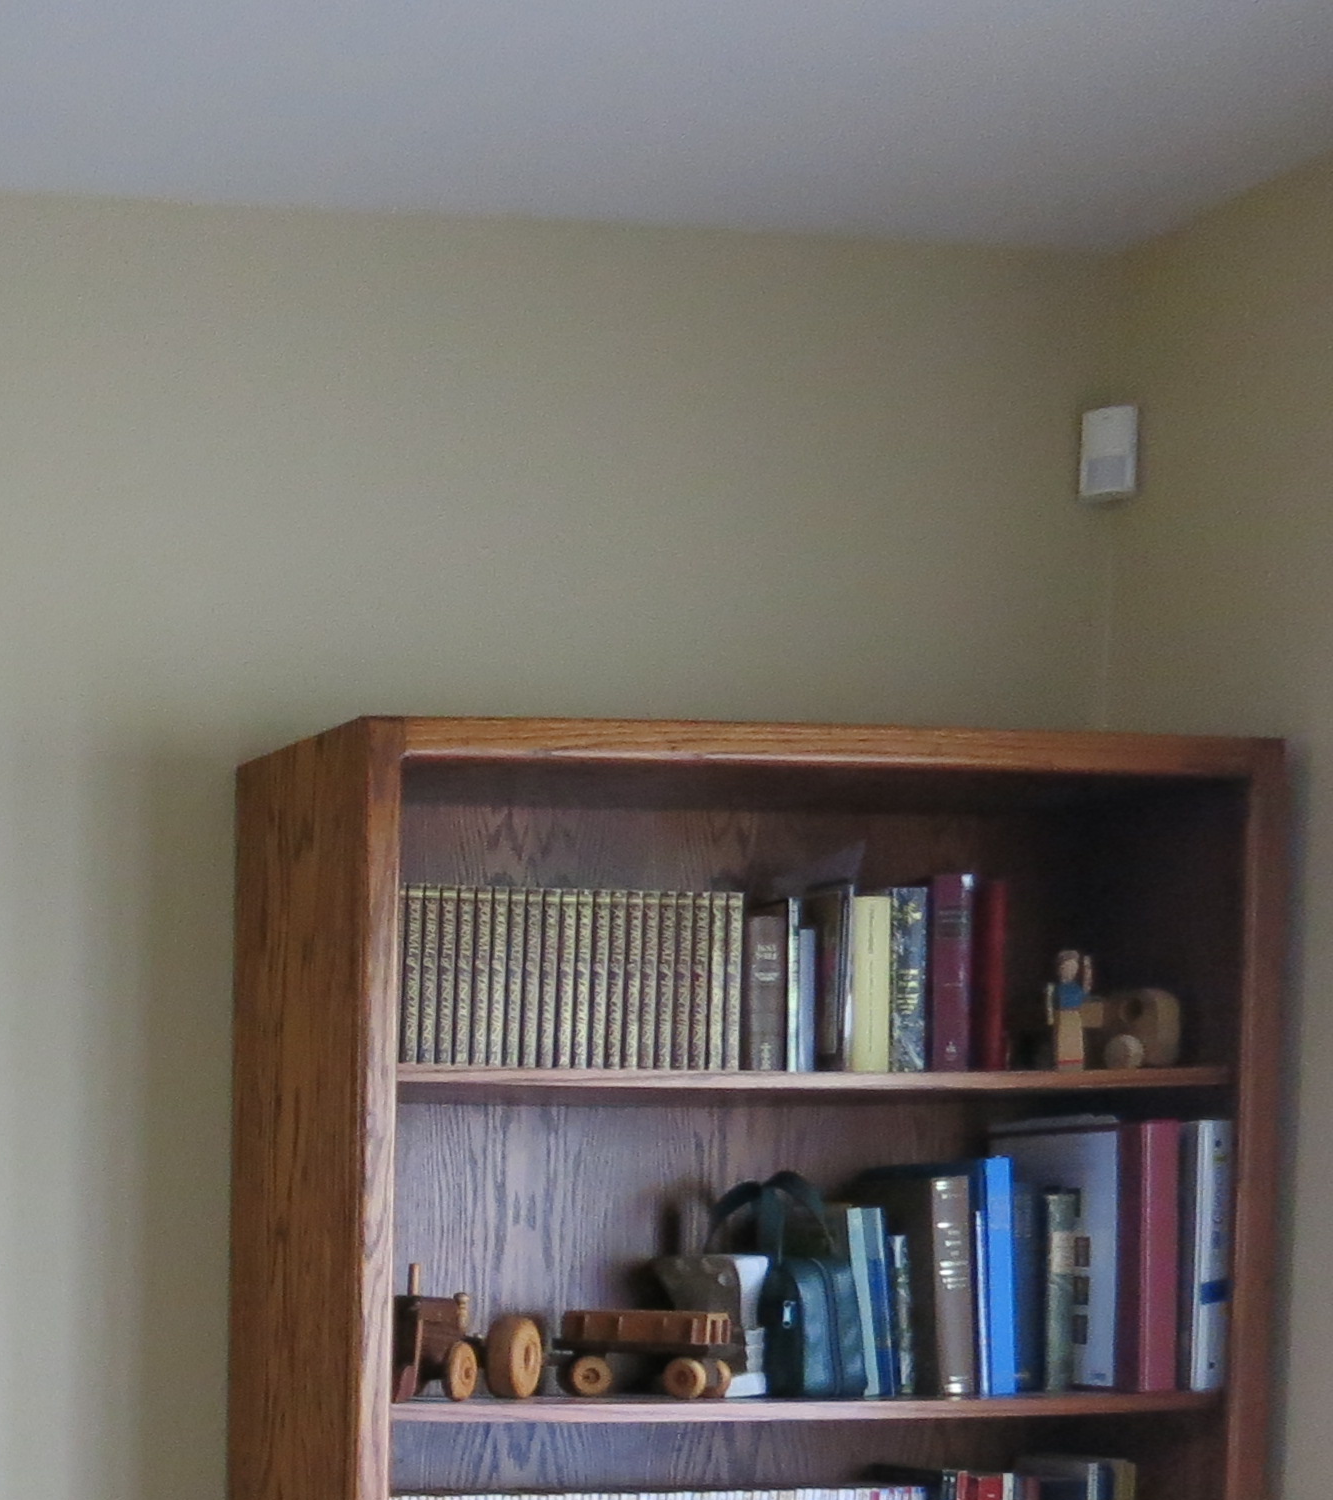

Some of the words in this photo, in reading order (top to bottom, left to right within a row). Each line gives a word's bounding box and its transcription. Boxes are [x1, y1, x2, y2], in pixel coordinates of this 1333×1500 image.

[408, 900, 421, 955] JOURNAL
[424, 900, 437, 956] JOURNAL
[442, 901, 454, 956] JOURNAL
[460, 902, 472, 958] JOURNAL
[478, 902, 491, 958] JOURNAL
[495, 904, 508, 959] JOURNAL
[511, 904, 524, 959] JOURNAL
[527, 905, 540, 960] JOURNAL
[545, 905, 558, 962] JOURNAL
[563, 906, 574, 962] JOURNAL
[578, 905, 591, 962] JOURNAL
[595, 906, 608, 962] JOURNAL
[612, 907, 624, 962] JOURNAL
[629, 907, 642, 963] JOURNAL
[645, 907, 658, 962] JOURNAL
[661, 908, 674, 964] JOURNAL
[679, 909, 691, 963] JOURNAL
[696, 909, 708, 963] JOURNAL
[729, 909, 742, 964] JOURNAL
